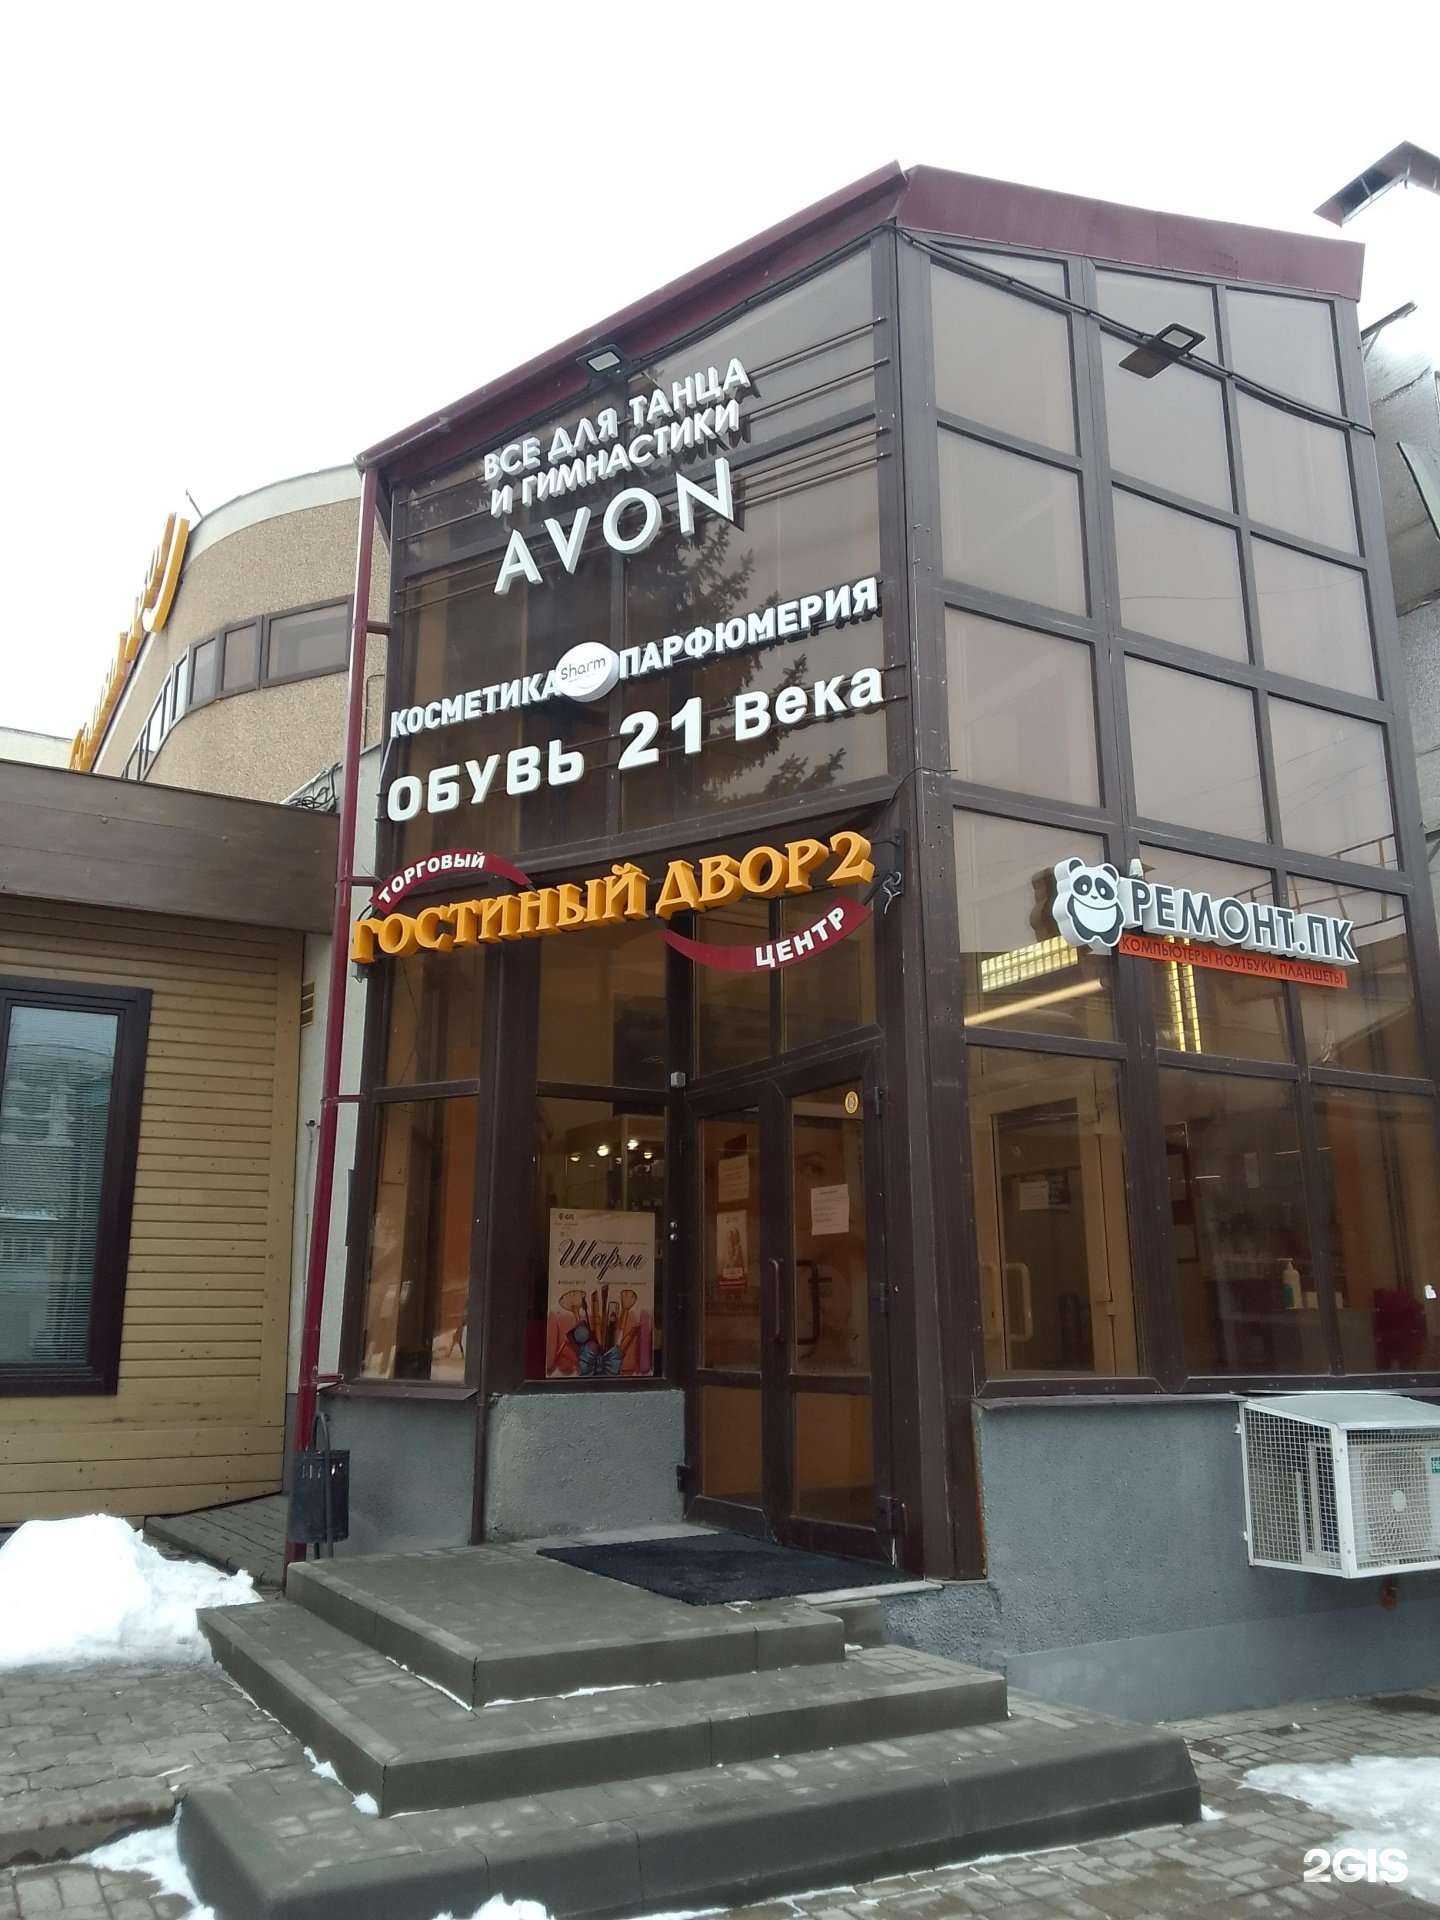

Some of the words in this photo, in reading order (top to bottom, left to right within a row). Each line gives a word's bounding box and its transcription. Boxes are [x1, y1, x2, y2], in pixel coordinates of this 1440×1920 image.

[483, 437, 540, 483] ВСЕ
[547, 406, 618, 464] ДЛЯ
[628, 358, 752, 429] ТАНЦА
[490, 487, 514, 518] И
[521, 399, 740, 508] ГИМНАСТИКИ
[494, 457, 735, 595] AVON
[560, 657, 606, 680] sharm
[619, 576, 878, 681] ПАРФЮМЕРИЯ
[387, 739, 585, 822] ОБУВЬ
[617, 696, 703, 770] 21
[733, 666, 884, 742] Века
[389, 672, 561, 739] КОСМЕТИКА
[351, 862, 651, 964] ГОСТИНЫЙ
[377, 850, 486, 905] ТОРГОВЫЙ
[1122, 878, 1361, 965] РЕМОНТ.ПК
[755, 905, 847, 969] ЦЕНТР
[1122, 937, 1211, 963] КОМПЬЮТЕРЫ
[1215, 954, 1277, 975] НОУТБУКИ
[1279, 962, 1344, 986] ПЛАНШЕТЫ
